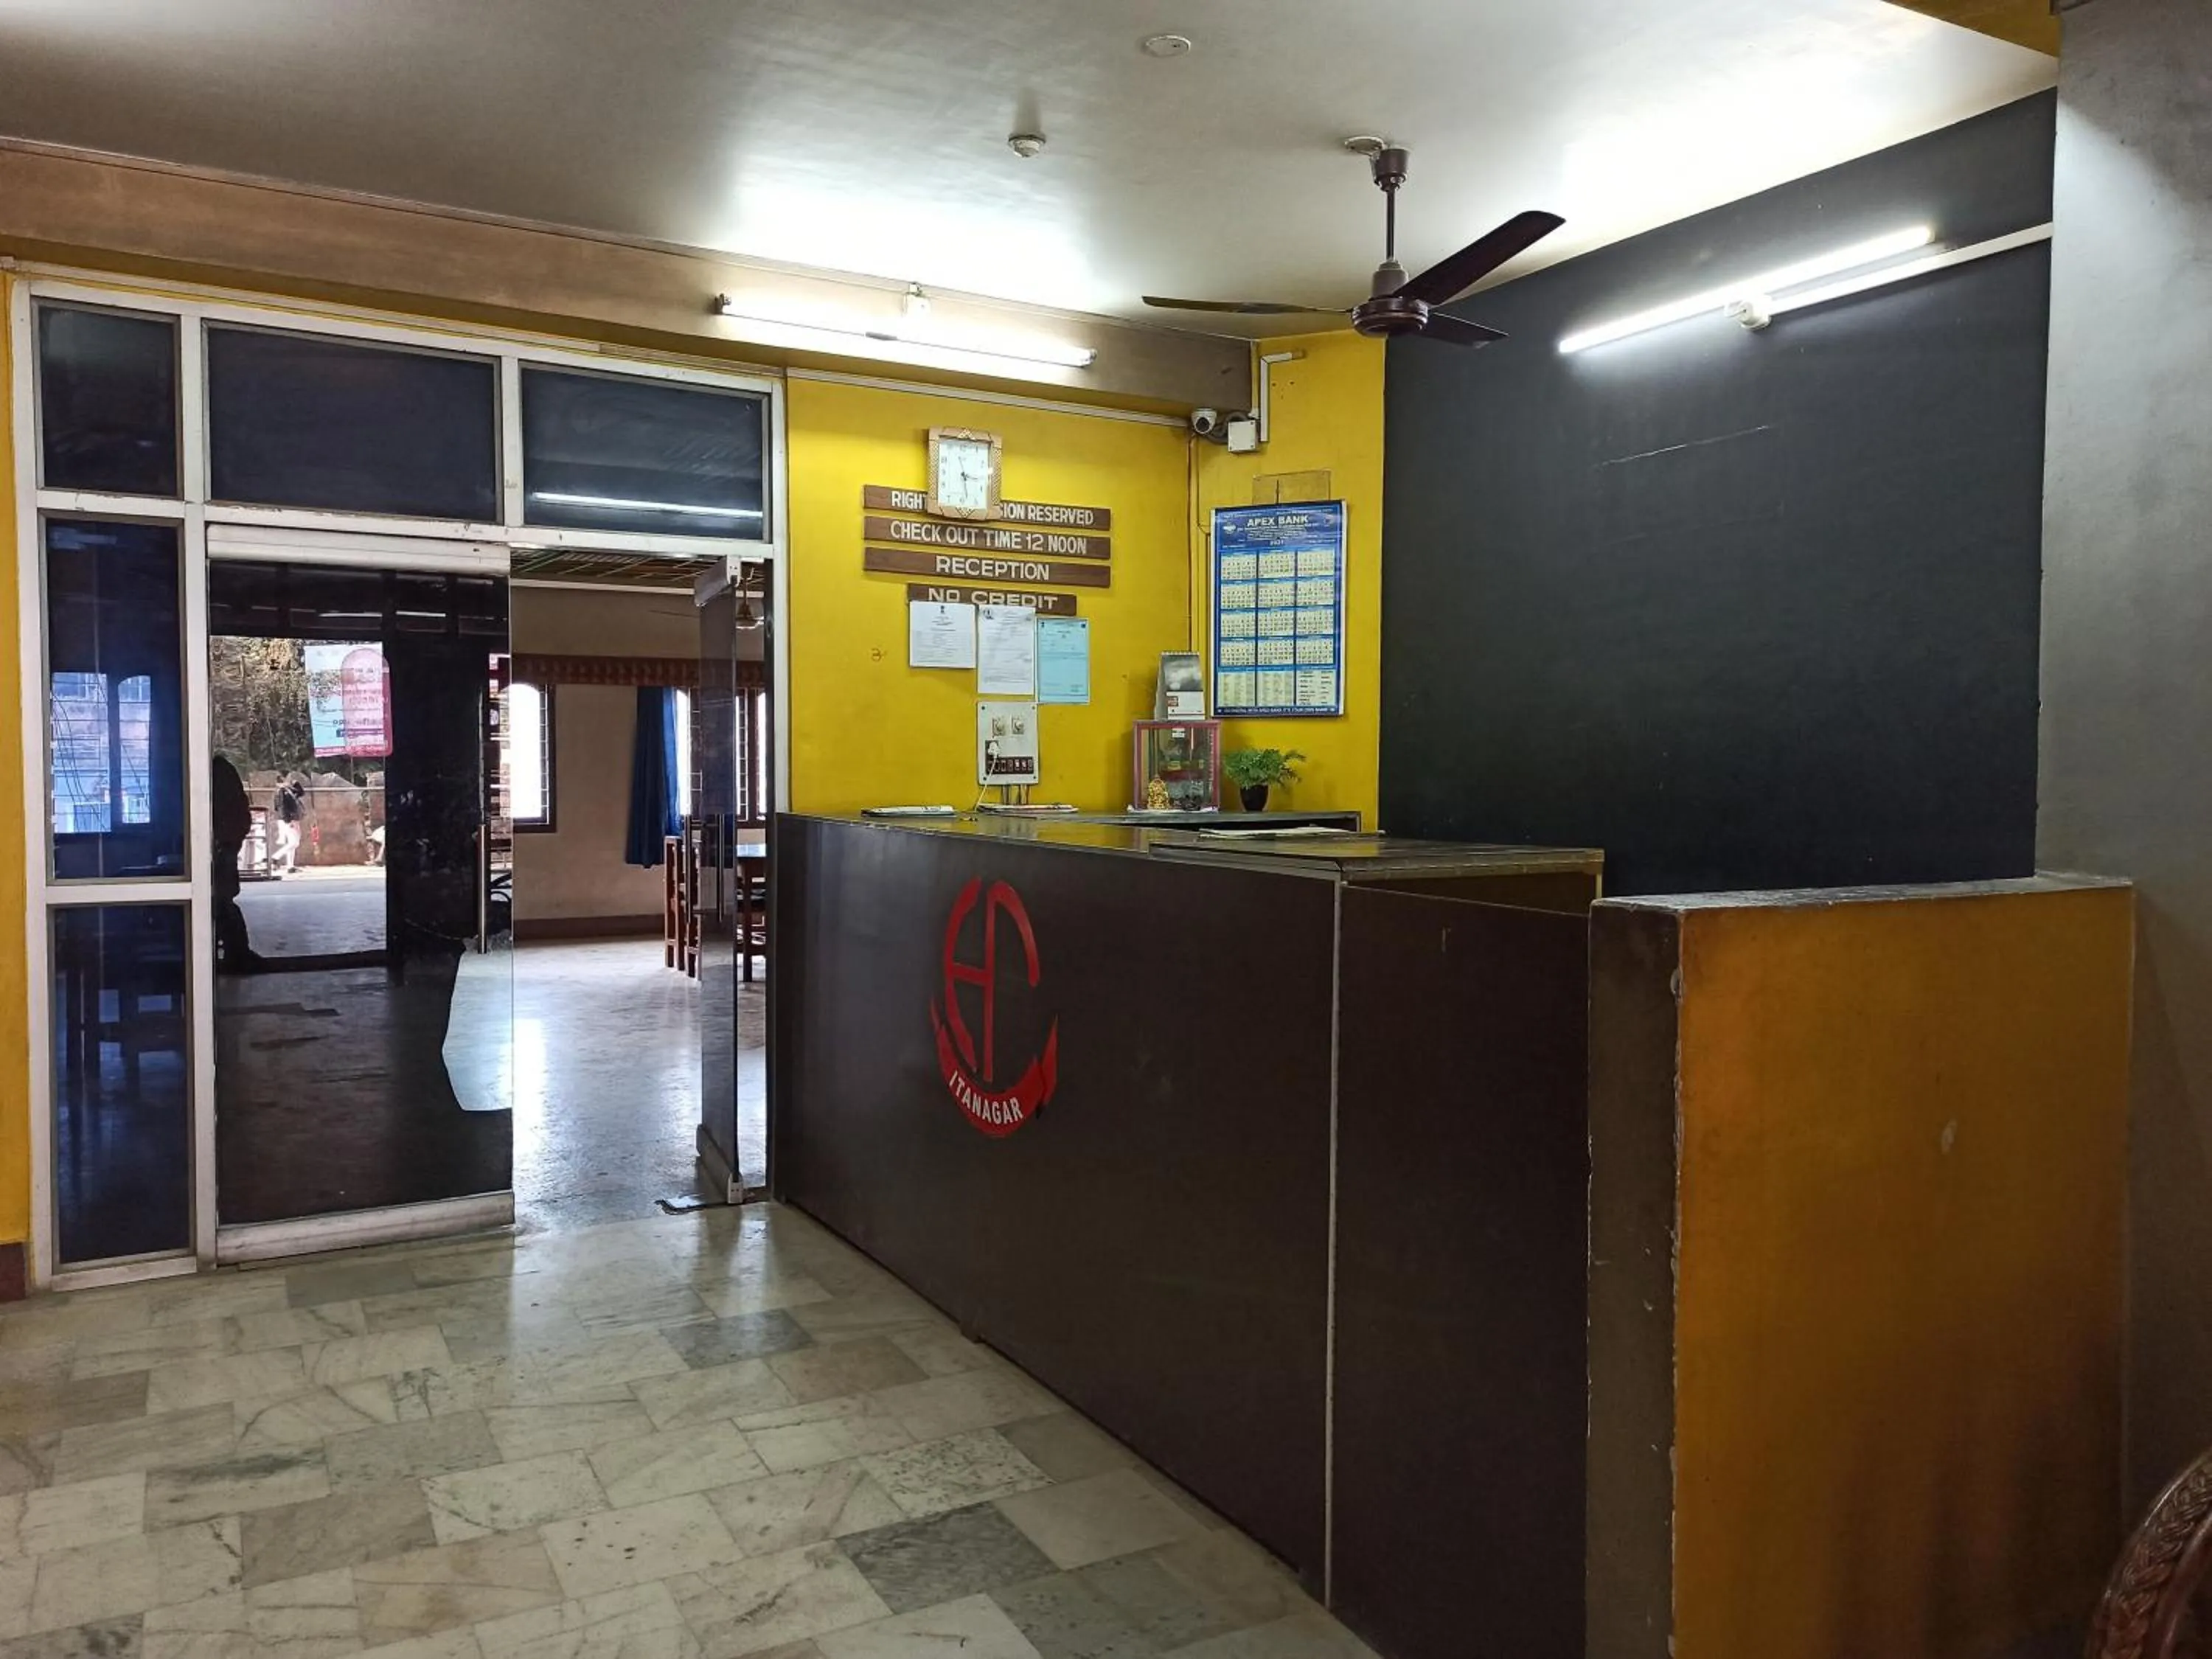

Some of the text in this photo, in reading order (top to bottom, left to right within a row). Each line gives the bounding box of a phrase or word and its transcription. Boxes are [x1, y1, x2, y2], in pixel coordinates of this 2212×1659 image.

[1028, 505, 1093, 525] RESERVED
[1247, 515, 1309, 526] APEX BANK
[891, 521, 1087, 554] CHECK OUT TIME 12 NOON
[936, 555, 1050, 581] RECEPTION
[928, 588, 1058, 609] NO CREDIT
[948, 1070, 1023, 1124] ITANAGAR
